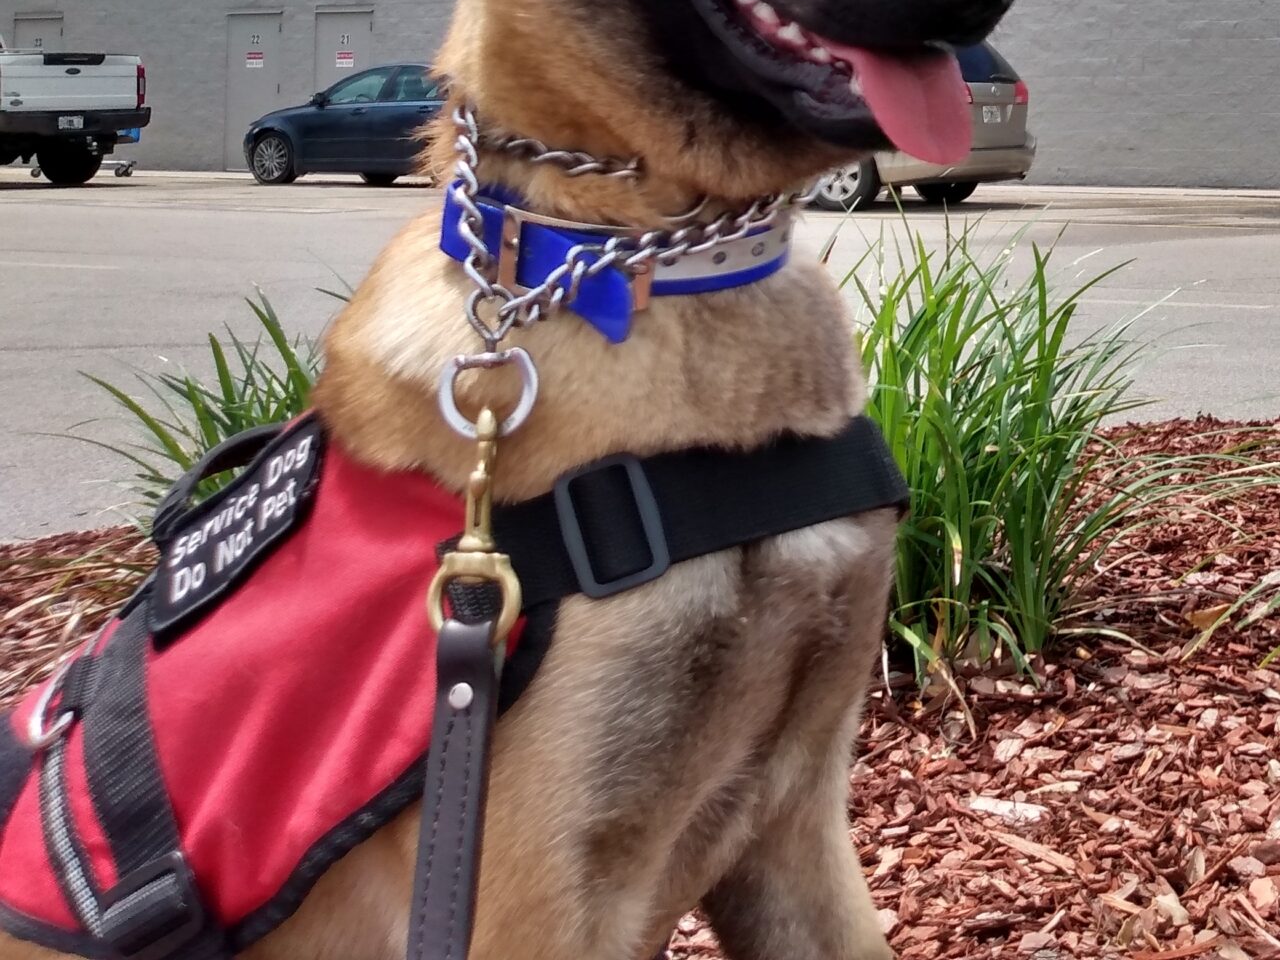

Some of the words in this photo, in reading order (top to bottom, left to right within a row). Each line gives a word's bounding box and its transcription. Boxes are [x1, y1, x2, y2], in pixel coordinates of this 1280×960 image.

[169, 483, 260, 568] Service
[265, 435, 314, 489] Dog
[169, 562, 207, 604] Do
[214, 518, 255, 573] Not
[257, 478, 297, 532] Pet
